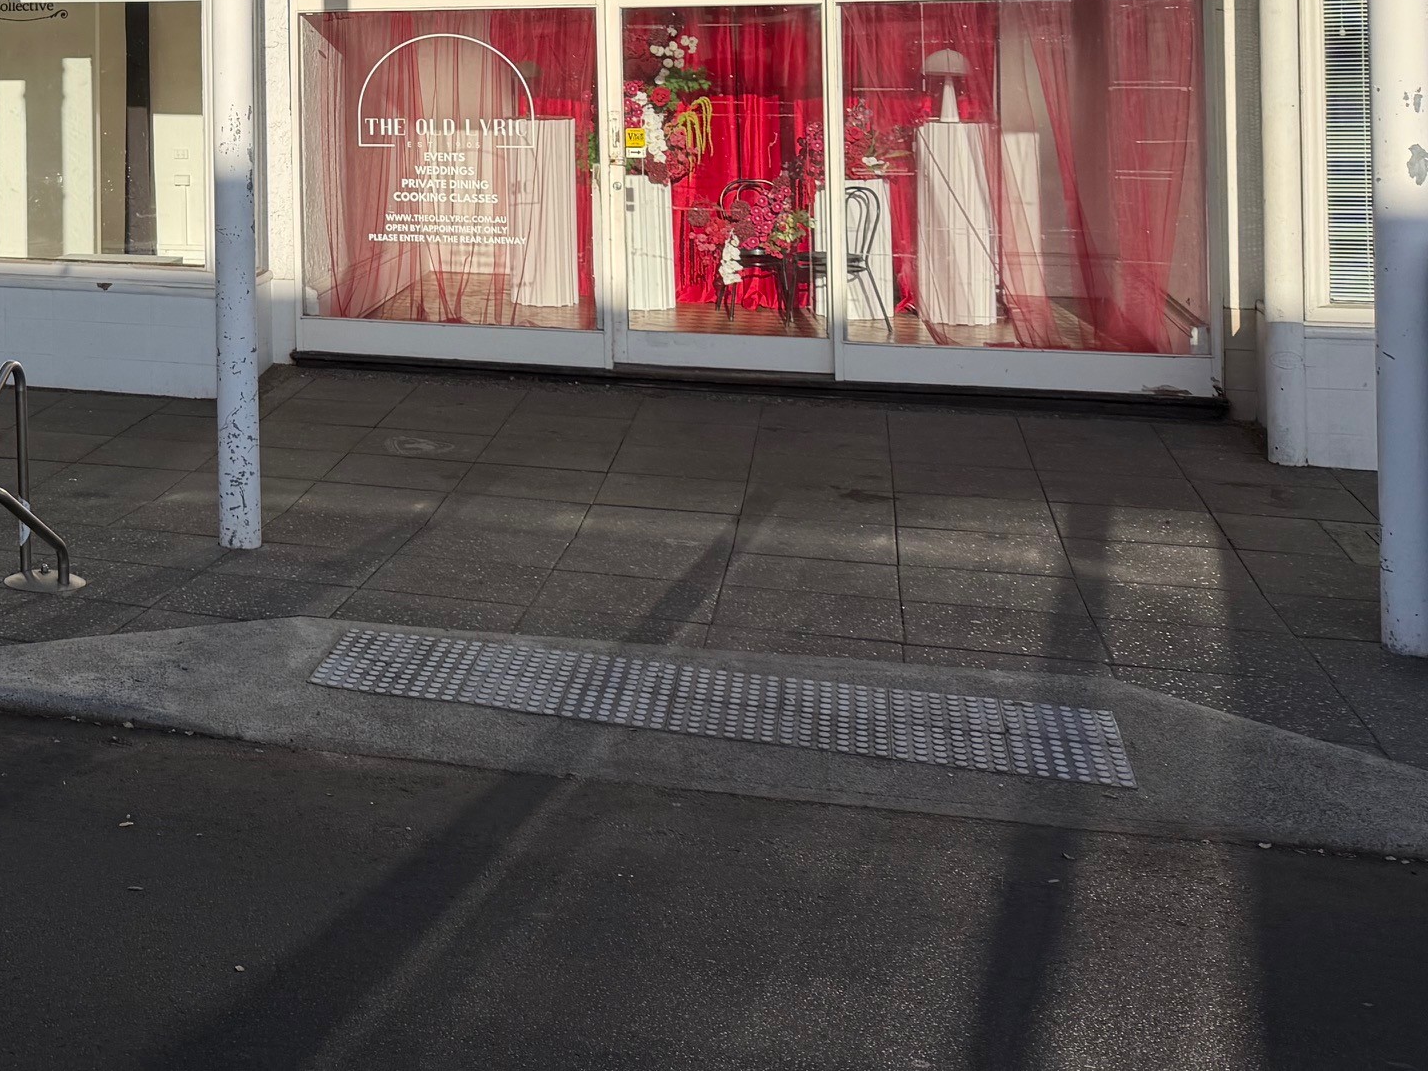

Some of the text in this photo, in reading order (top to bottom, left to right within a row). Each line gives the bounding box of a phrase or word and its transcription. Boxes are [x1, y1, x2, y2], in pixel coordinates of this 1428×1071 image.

[365, 118, 528, 137] THE OLD LYRIC
[424, 152, 465, 162] EVENTS
[415, 165, 475, 176] WEDDINGS
[401, 179, 489, 190] PRIVATE DINING
[393, 192, 499, 204] COOKING CLASSES
[385, 213, 507, 224] WWW.THEOLDLYRIC.COM.AU
[385, 224, 508, 235] OPEN BY APPOINTMENT ONLY
[368, 233, 527, 245] PLEASE ENTER VIA THE REAR LANEWAY
